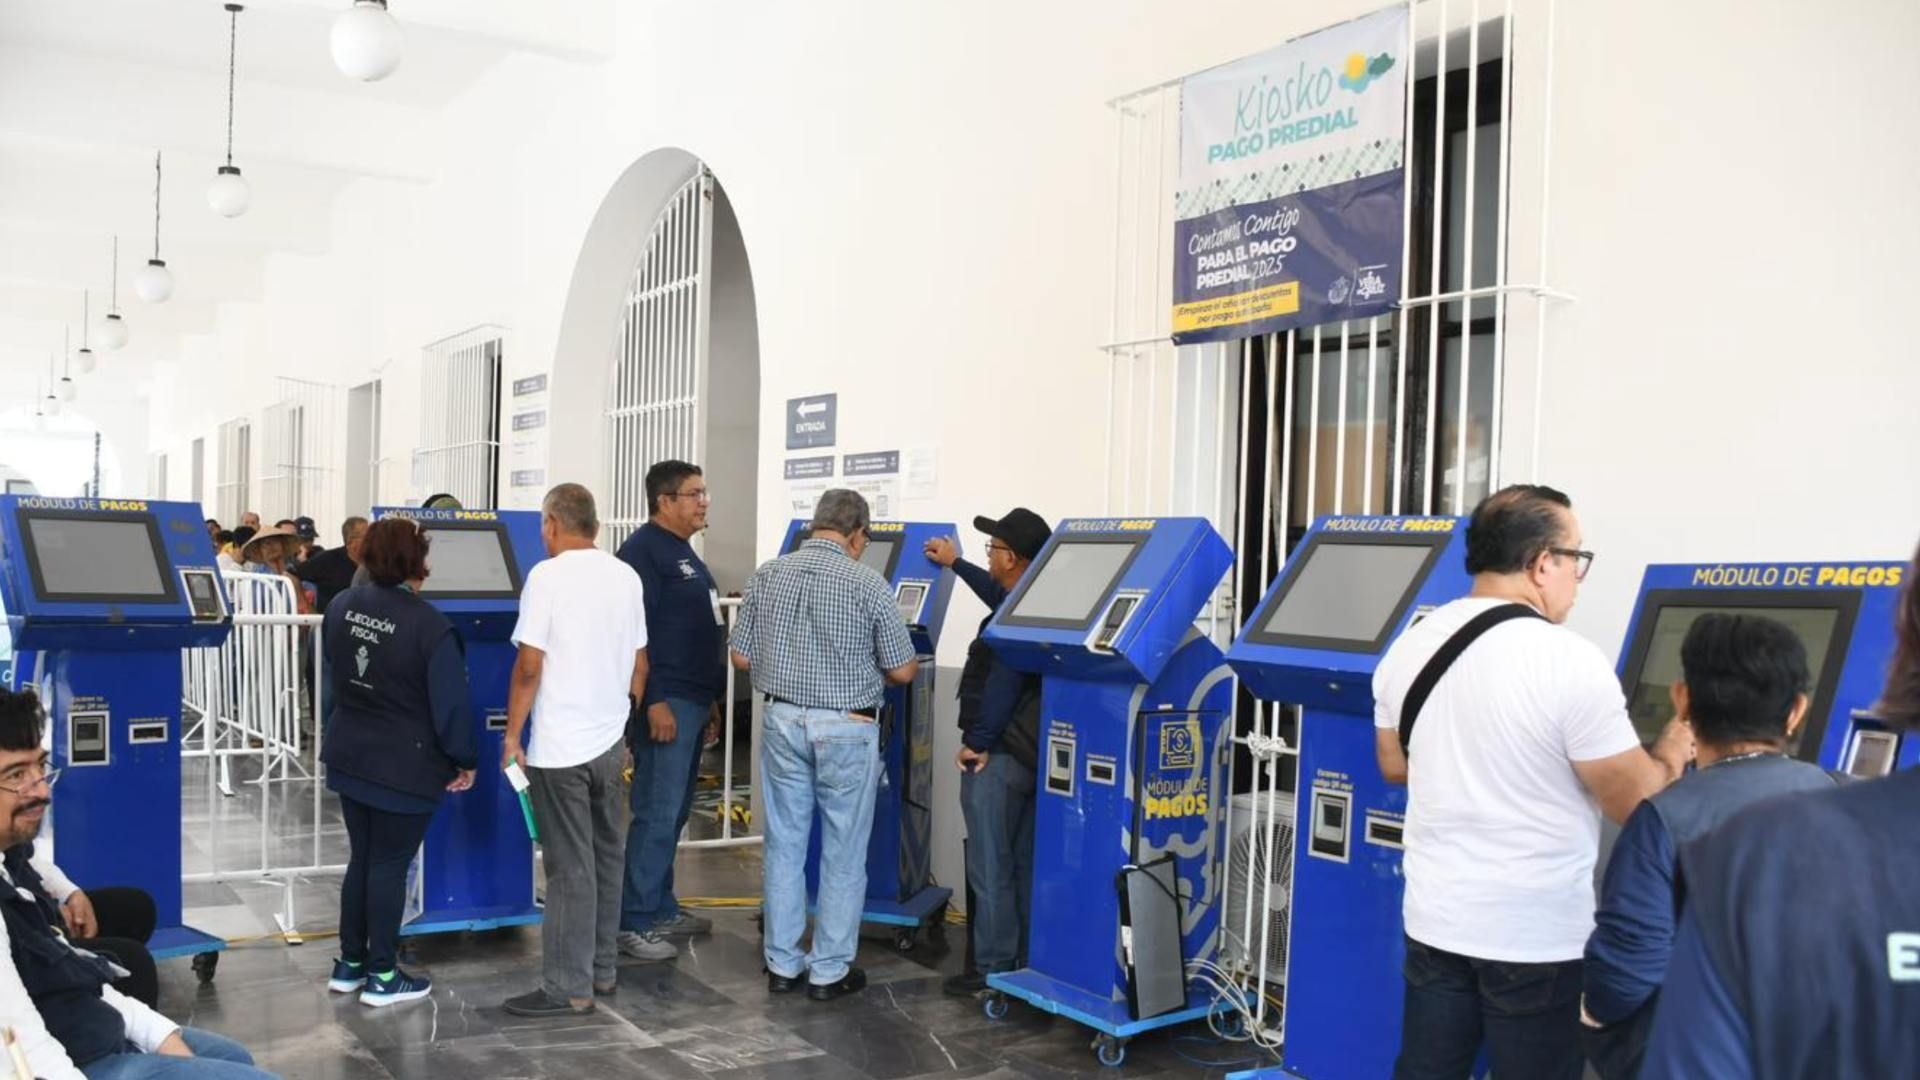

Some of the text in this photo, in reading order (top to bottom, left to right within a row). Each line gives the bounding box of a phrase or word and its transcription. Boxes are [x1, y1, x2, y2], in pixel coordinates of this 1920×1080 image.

[1234, 61, 1334, 137] Kiosko
[1207, 107, 1359, 165] PAGO PREDIAL
[1243, 206, 1300, 237] Contigo
[1197, 236, 1297, 272] PARA EL PAGO
[1196, 254, 1287, 290] PREDIAL 2025
[795, 421, 826, 433] ENTRADA
[18, 497, 147, 511] MÓDULO DE PAGOS
[437, 510, 451, 520] DE
[455, 511, 498, 521] PAGOS
[869, 523, 905, 532] AGOS
[1120, 520, 1156, 531] PAGOS
[1323, 517, 1456, 532] MÓDULO DE PAGOS
[1692, 564, 1903, 587] MÓDULO DE PAGOS
[345, 609, 396, 634] EJECUCIÓN
[350, 625, 380, 645] FISCAL
[1145, 793, 1208, 820] PAGOS
